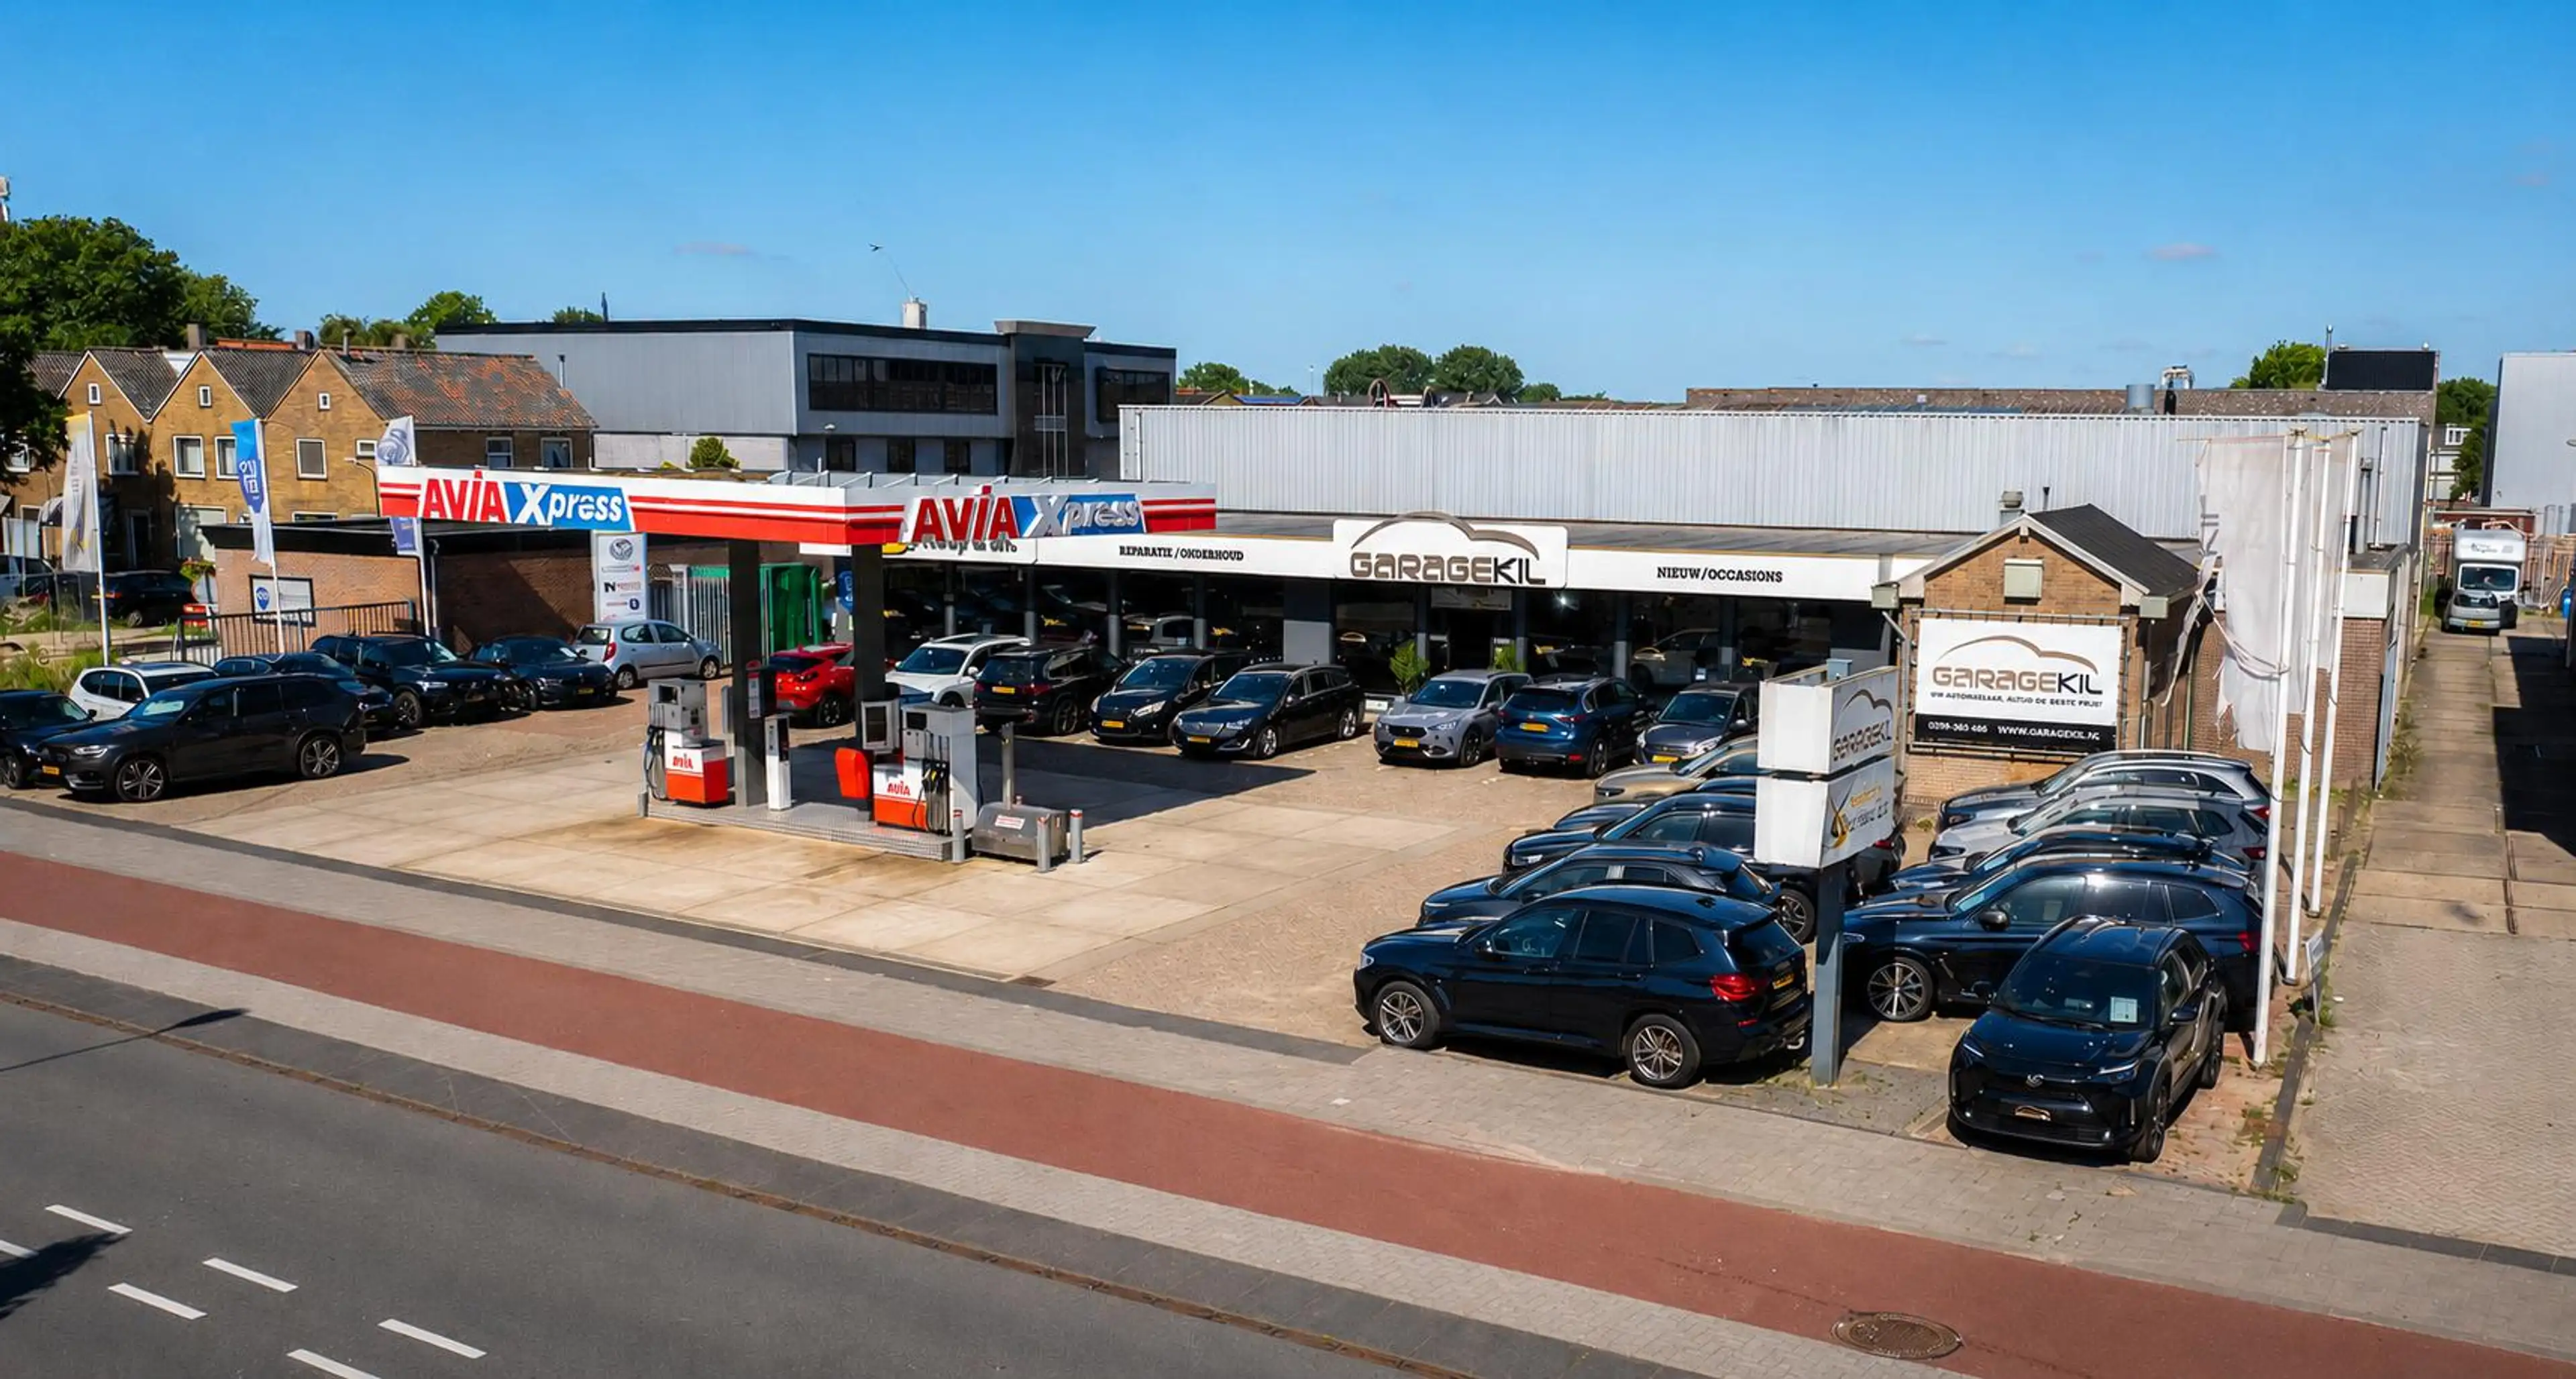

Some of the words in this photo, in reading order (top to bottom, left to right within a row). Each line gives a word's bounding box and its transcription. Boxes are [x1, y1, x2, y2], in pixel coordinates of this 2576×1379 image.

[514, 482, 623, 527] Xpress
[1022, 495, 1142, 537] Xpress
[1656, 567, 1783, 583] NIEUW/OCCASIONS
[2035, 697, 2047, 705] DE
[2050, 698, 2076, 706] BESTE
